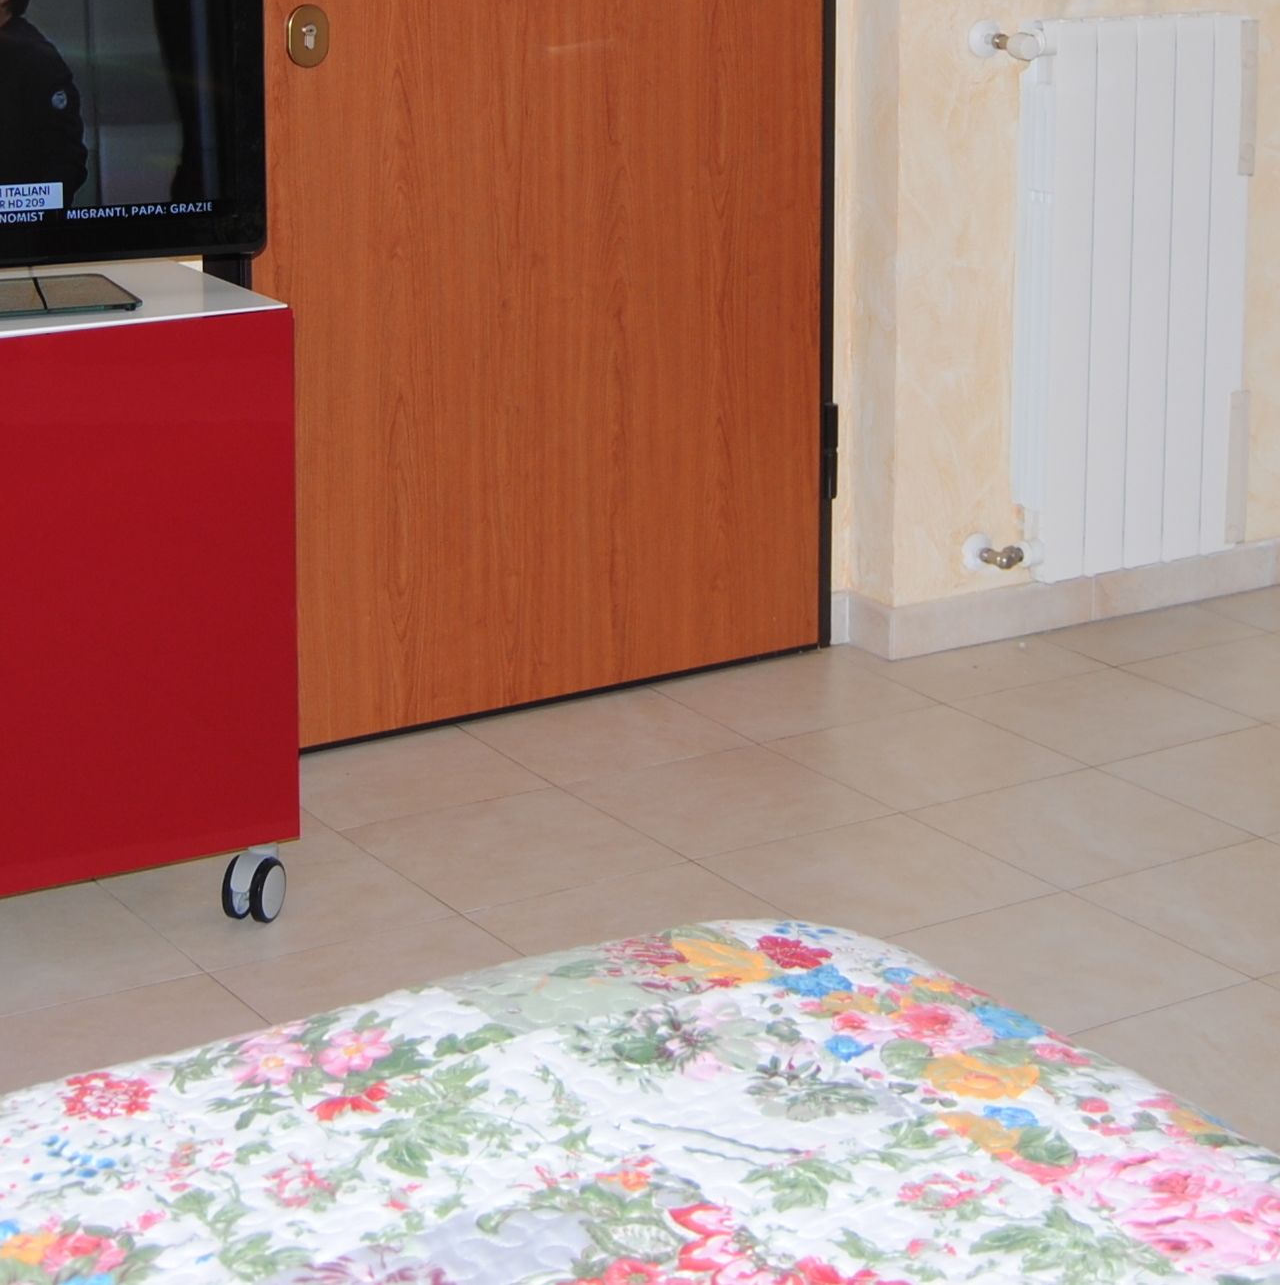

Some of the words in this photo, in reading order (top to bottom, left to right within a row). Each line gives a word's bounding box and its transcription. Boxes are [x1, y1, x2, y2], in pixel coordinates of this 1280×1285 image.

[5, 185, 50, 197] ITALIANI
[8, 199, 23, 209] HD
[25, 198, 45, 208] 209
[67, 206, 128, 219] MIGRANTI,
[131, 204, 167, 216] PAPA:
[170, 201, 213, 214] GRAZIE
